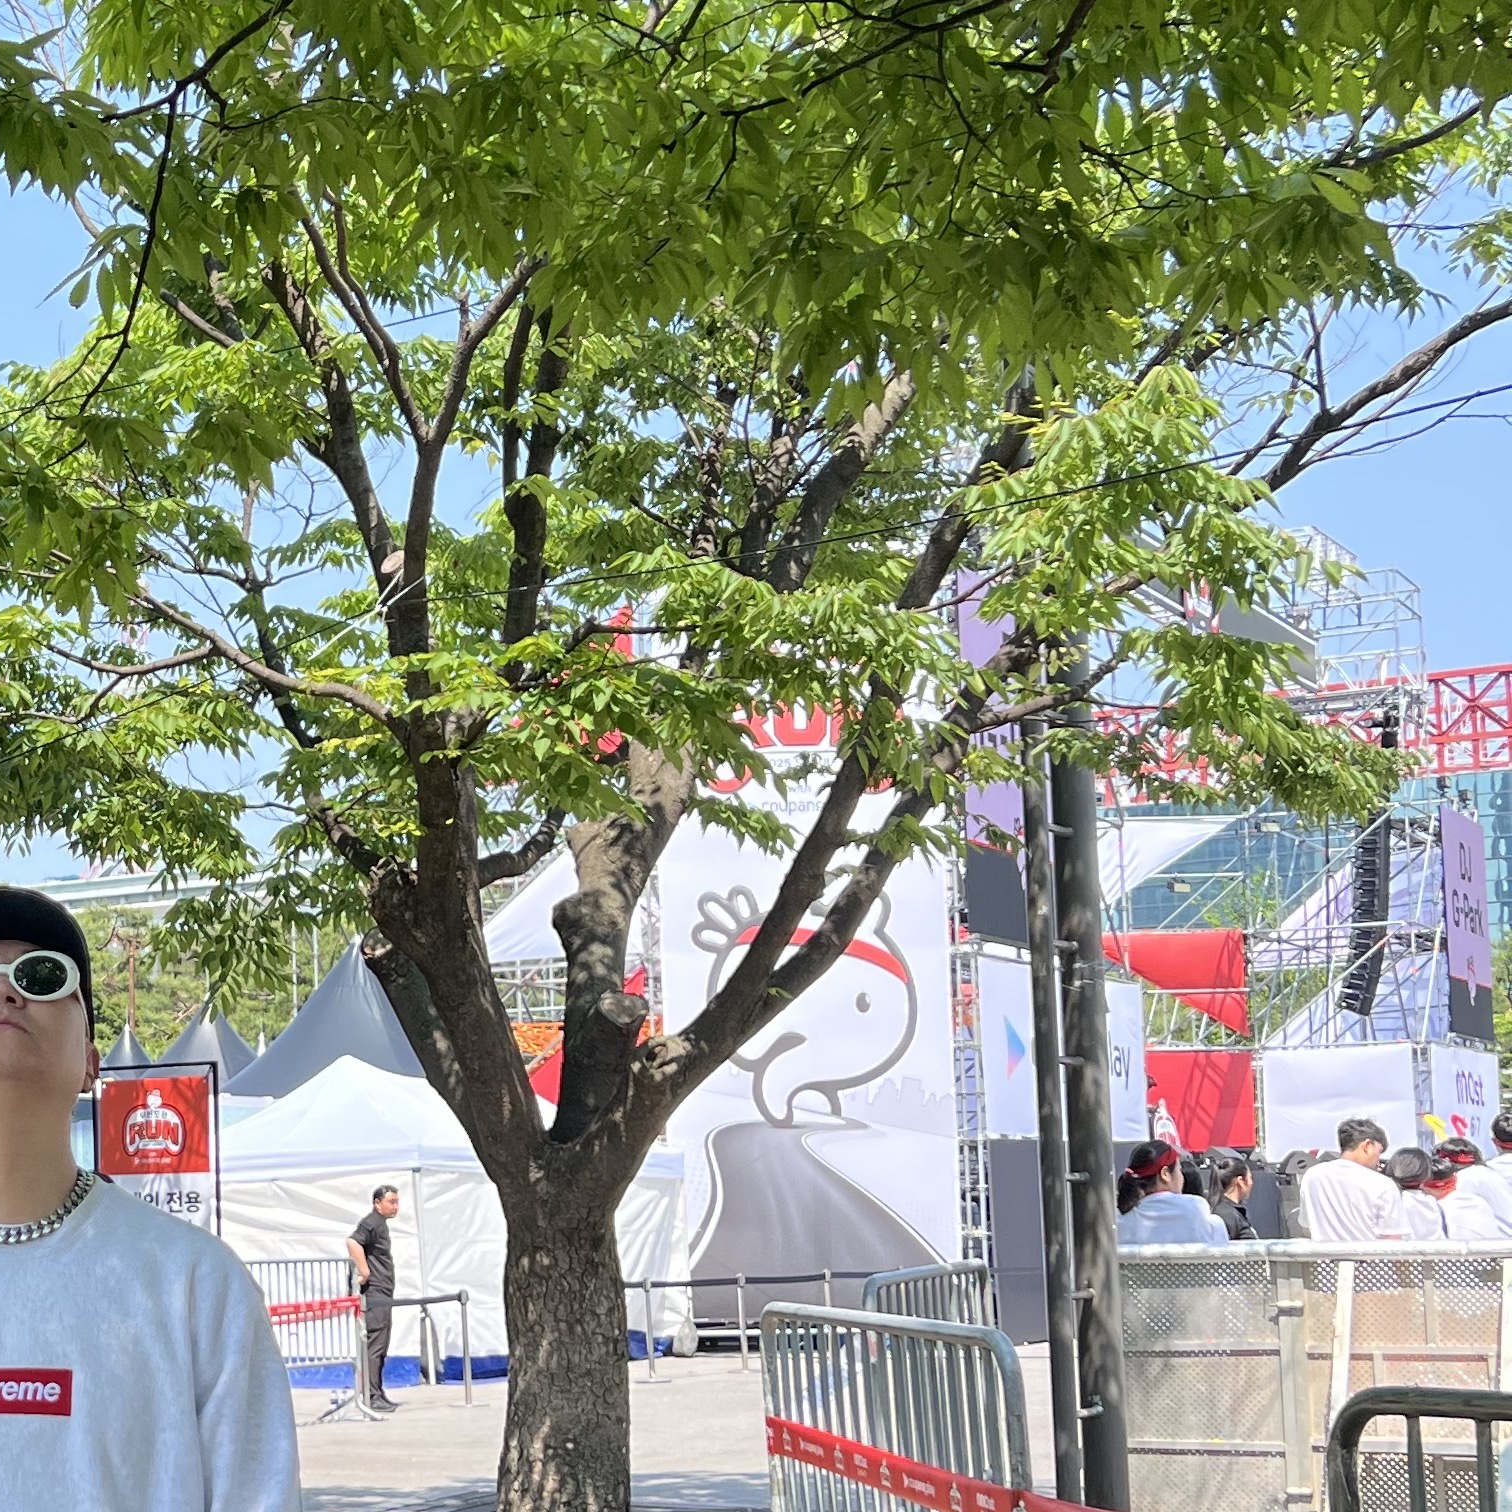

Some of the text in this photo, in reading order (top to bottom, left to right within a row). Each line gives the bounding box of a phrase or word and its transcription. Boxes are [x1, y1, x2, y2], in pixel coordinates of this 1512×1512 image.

[1459, 841, 1472, 883] DJ
[1451, 888, 1485, 938] G-Park
[1107, 1030, 1131, 1092] lay
[128, 1119, 180, 1146] RUN
[166, 1190, 203, 1214] 전용
